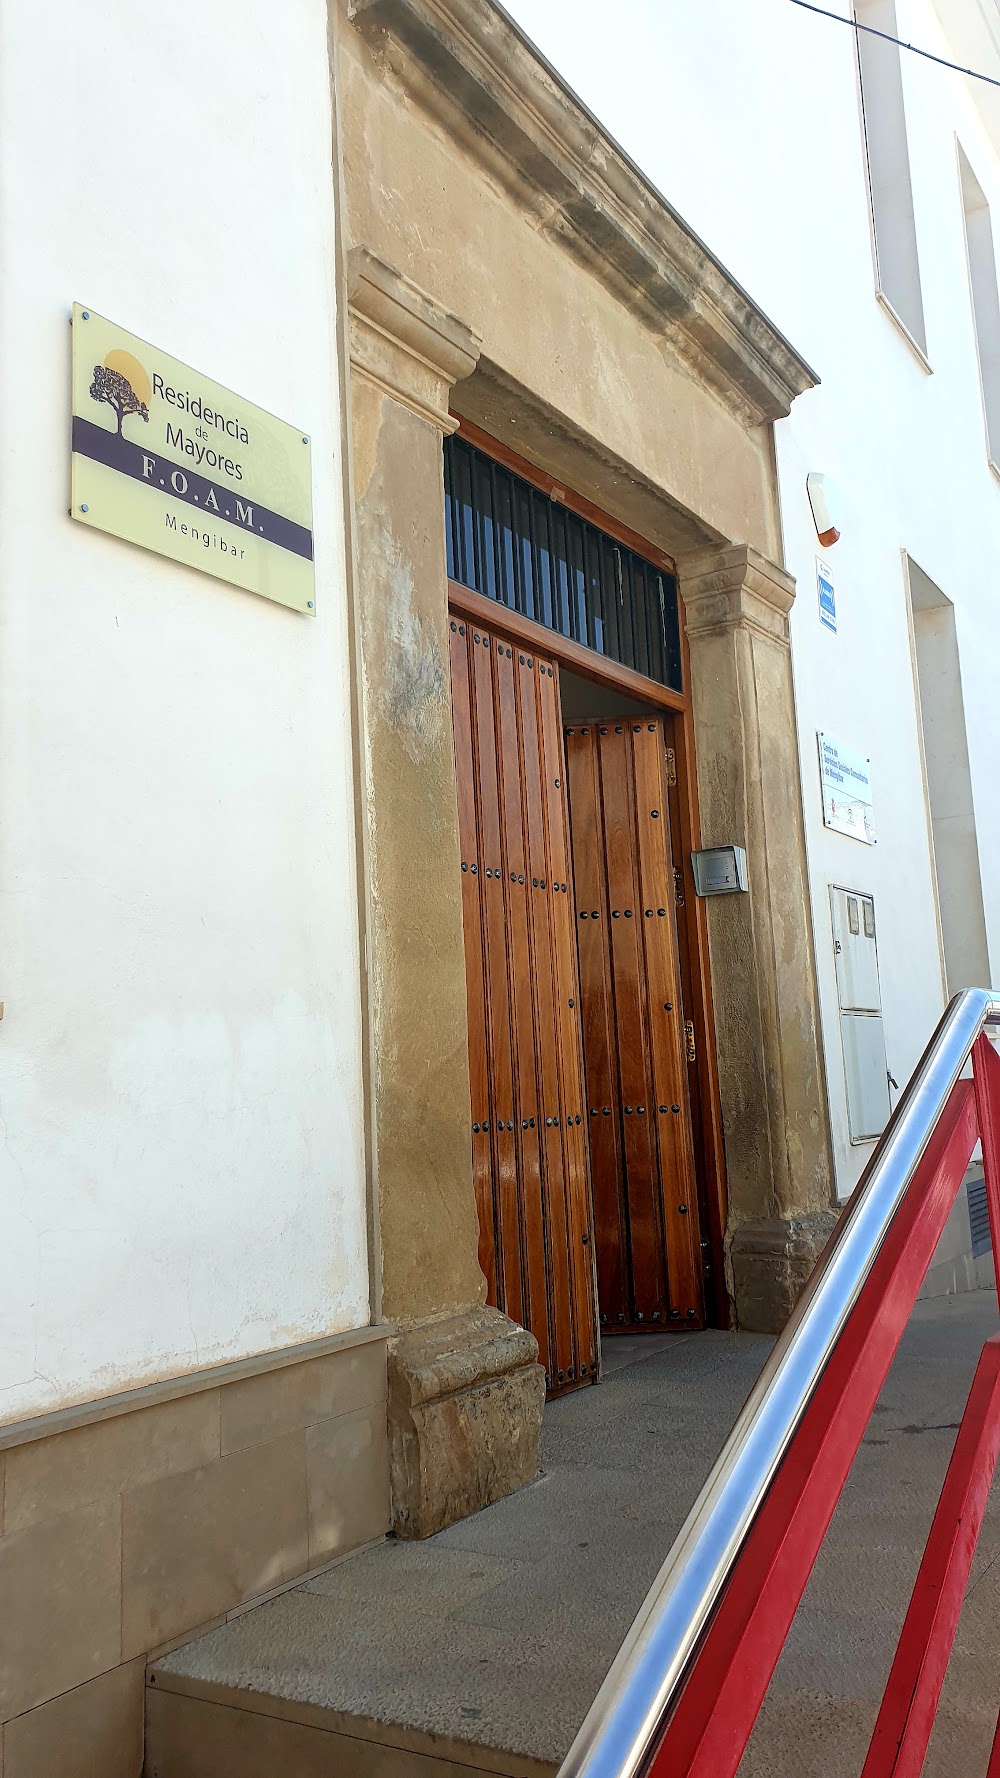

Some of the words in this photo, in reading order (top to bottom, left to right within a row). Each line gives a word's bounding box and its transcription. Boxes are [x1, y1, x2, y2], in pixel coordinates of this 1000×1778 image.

[152, 372, 249, 445] Residencia
[195, 425, 208, 442] de
[166, 422, 243, 480] Mayores
[141, 454, 264, 532] F.O.A.M.
[165, 513, 245, 559] Mengibar
